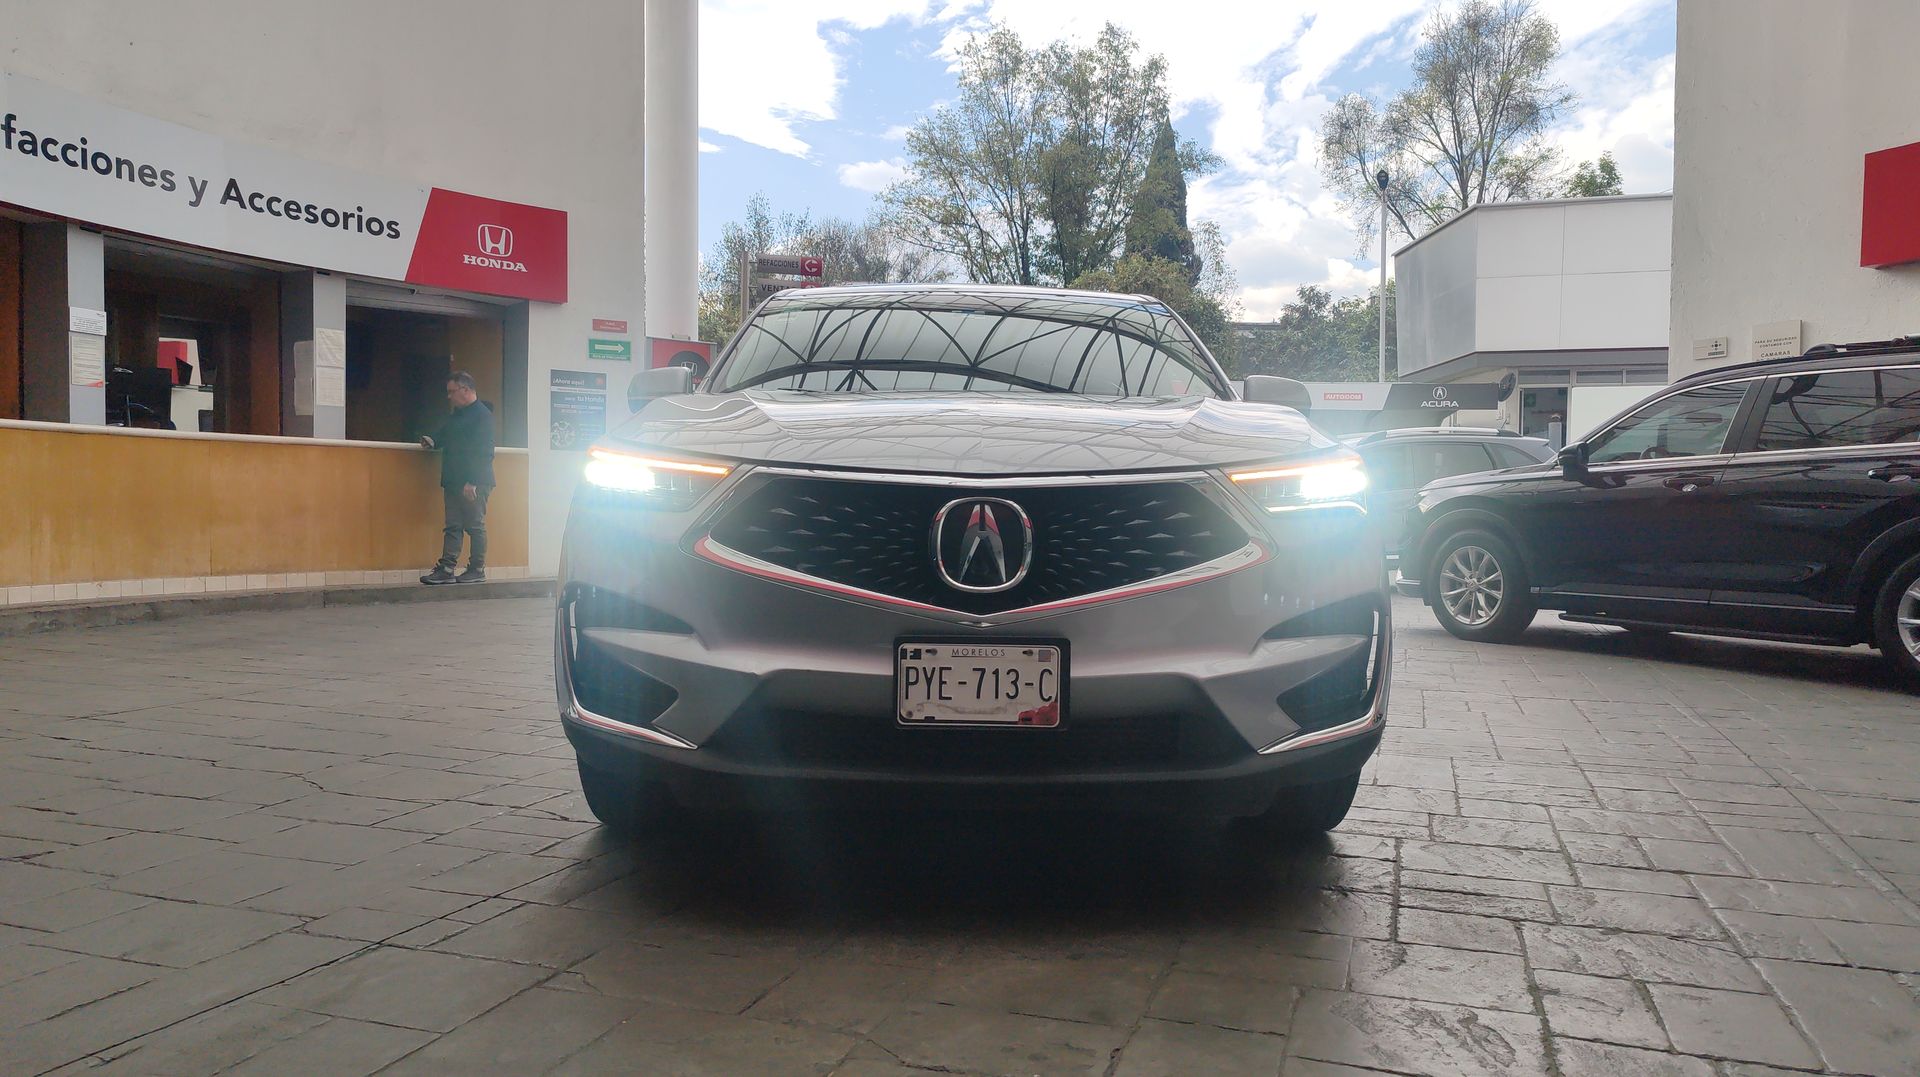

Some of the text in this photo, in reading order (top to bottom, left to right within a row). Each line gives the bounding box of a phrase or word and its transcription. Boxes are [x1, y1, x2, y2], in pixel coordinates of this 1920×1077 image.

[1, 113, 401, 240] facciones y Accesorios
[463, 254, 528, 272] HONDA
[758, 258, 799, 268] REFACCIONES
[1420, 400, 1459, 408] ACURA
[951, 648, 1006, 656] MORELOS
[904, 666, 1053, 702] PYE-713-C
